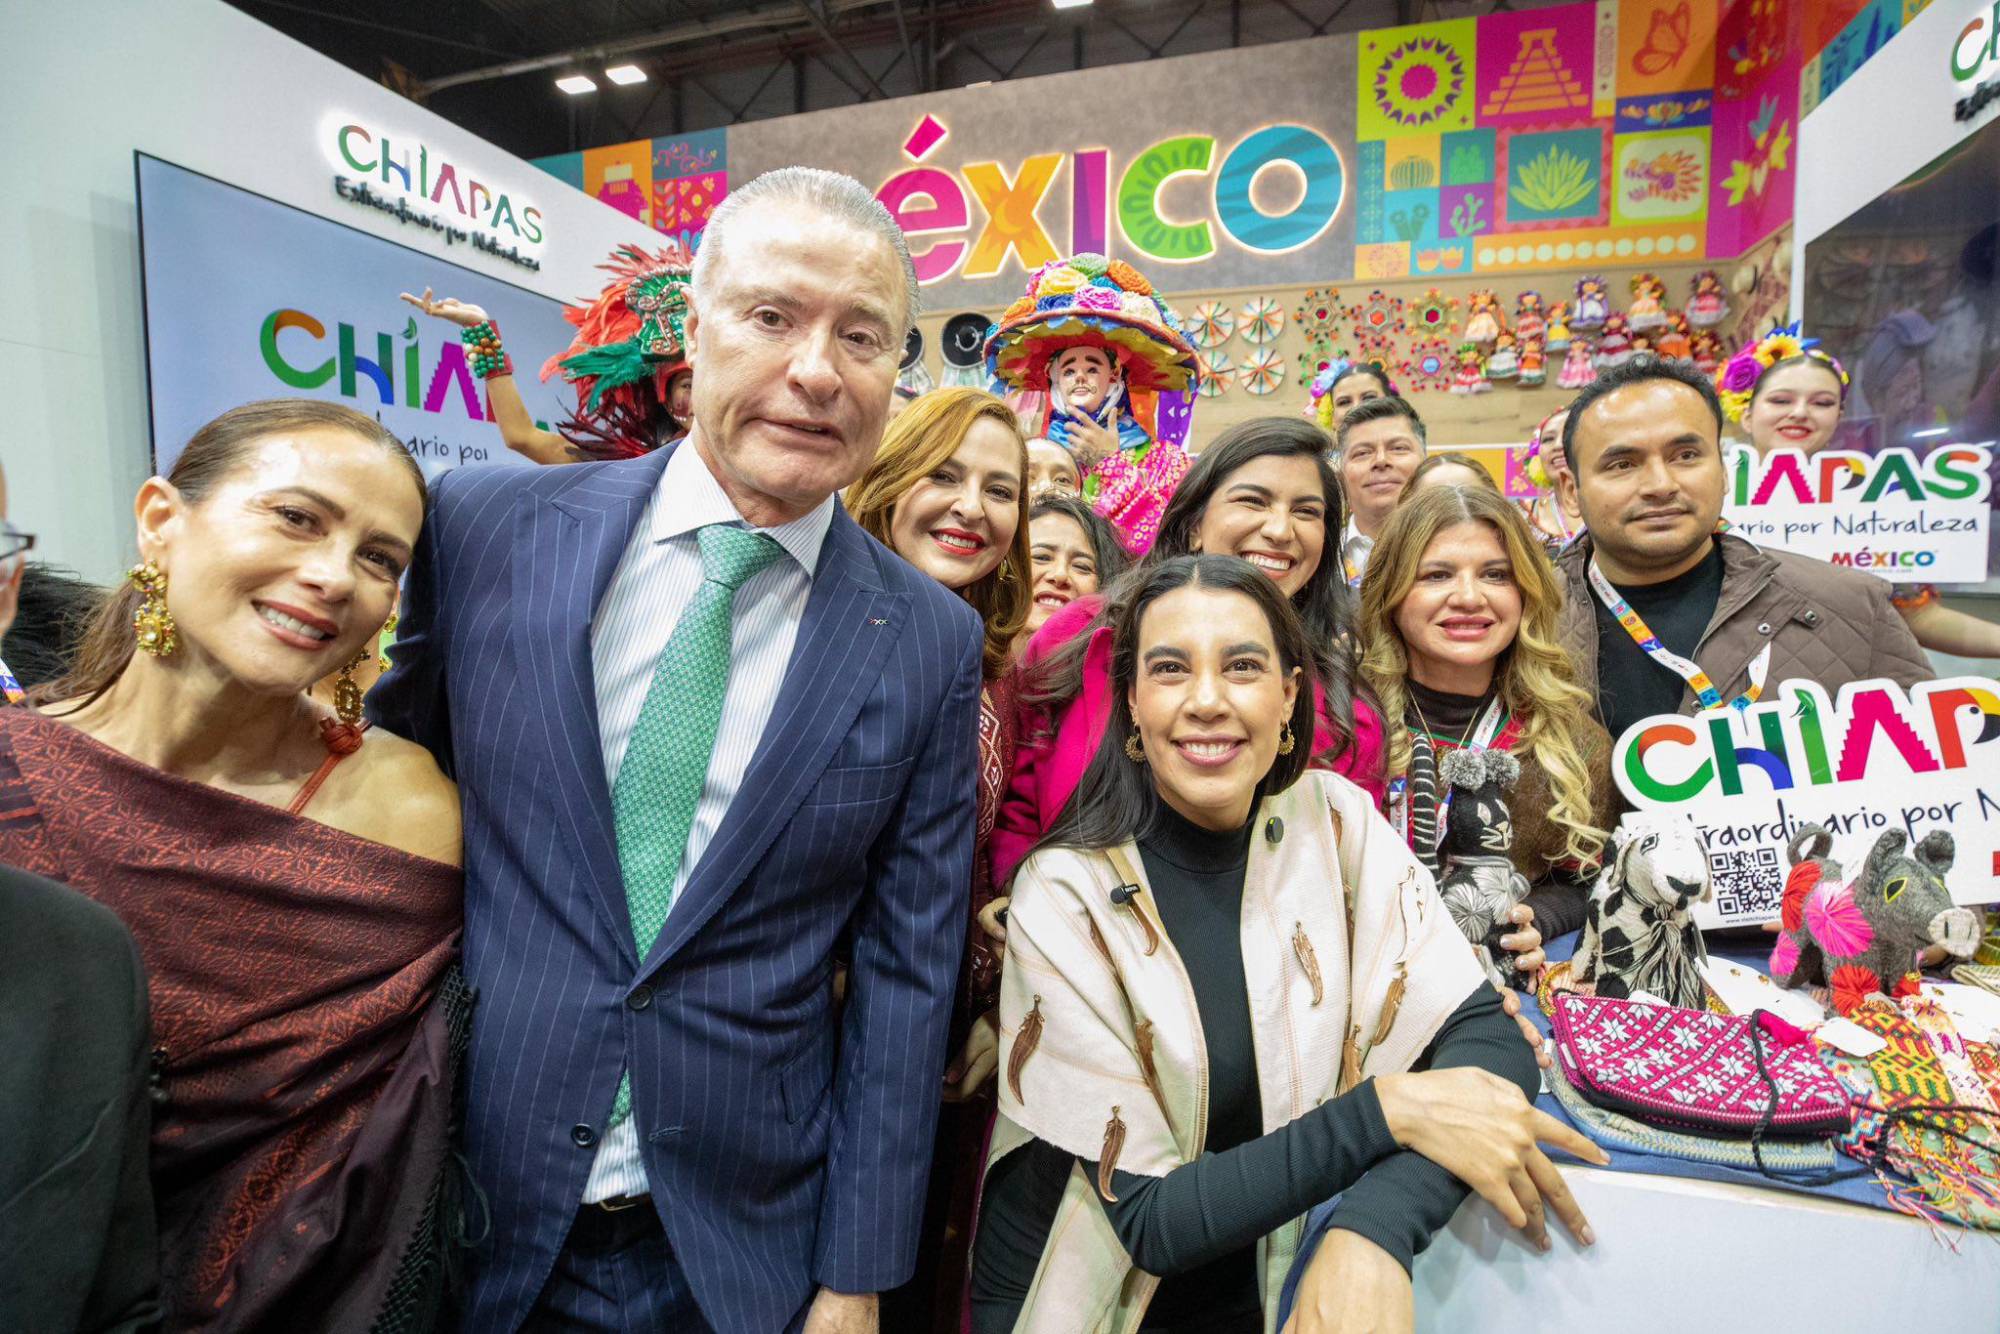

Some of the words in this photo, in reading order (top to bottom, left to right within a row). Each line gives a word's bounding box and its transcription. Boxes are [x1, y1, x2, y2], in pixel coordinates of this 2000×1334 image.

[338, 125, 542, 244] CHIAPAS
[873, 114, 1346, 286] éXICO
[260, 308, 497, 425] CHIA
[1732, 450, 1981, 506] IAPAS
[1784, 522, 1823, 544] por
[1833, 510, 1979, 537] Naturaleza
[1625, 688, 2000, 803] CHIAP
[1902, 801, 1962, 843] por
